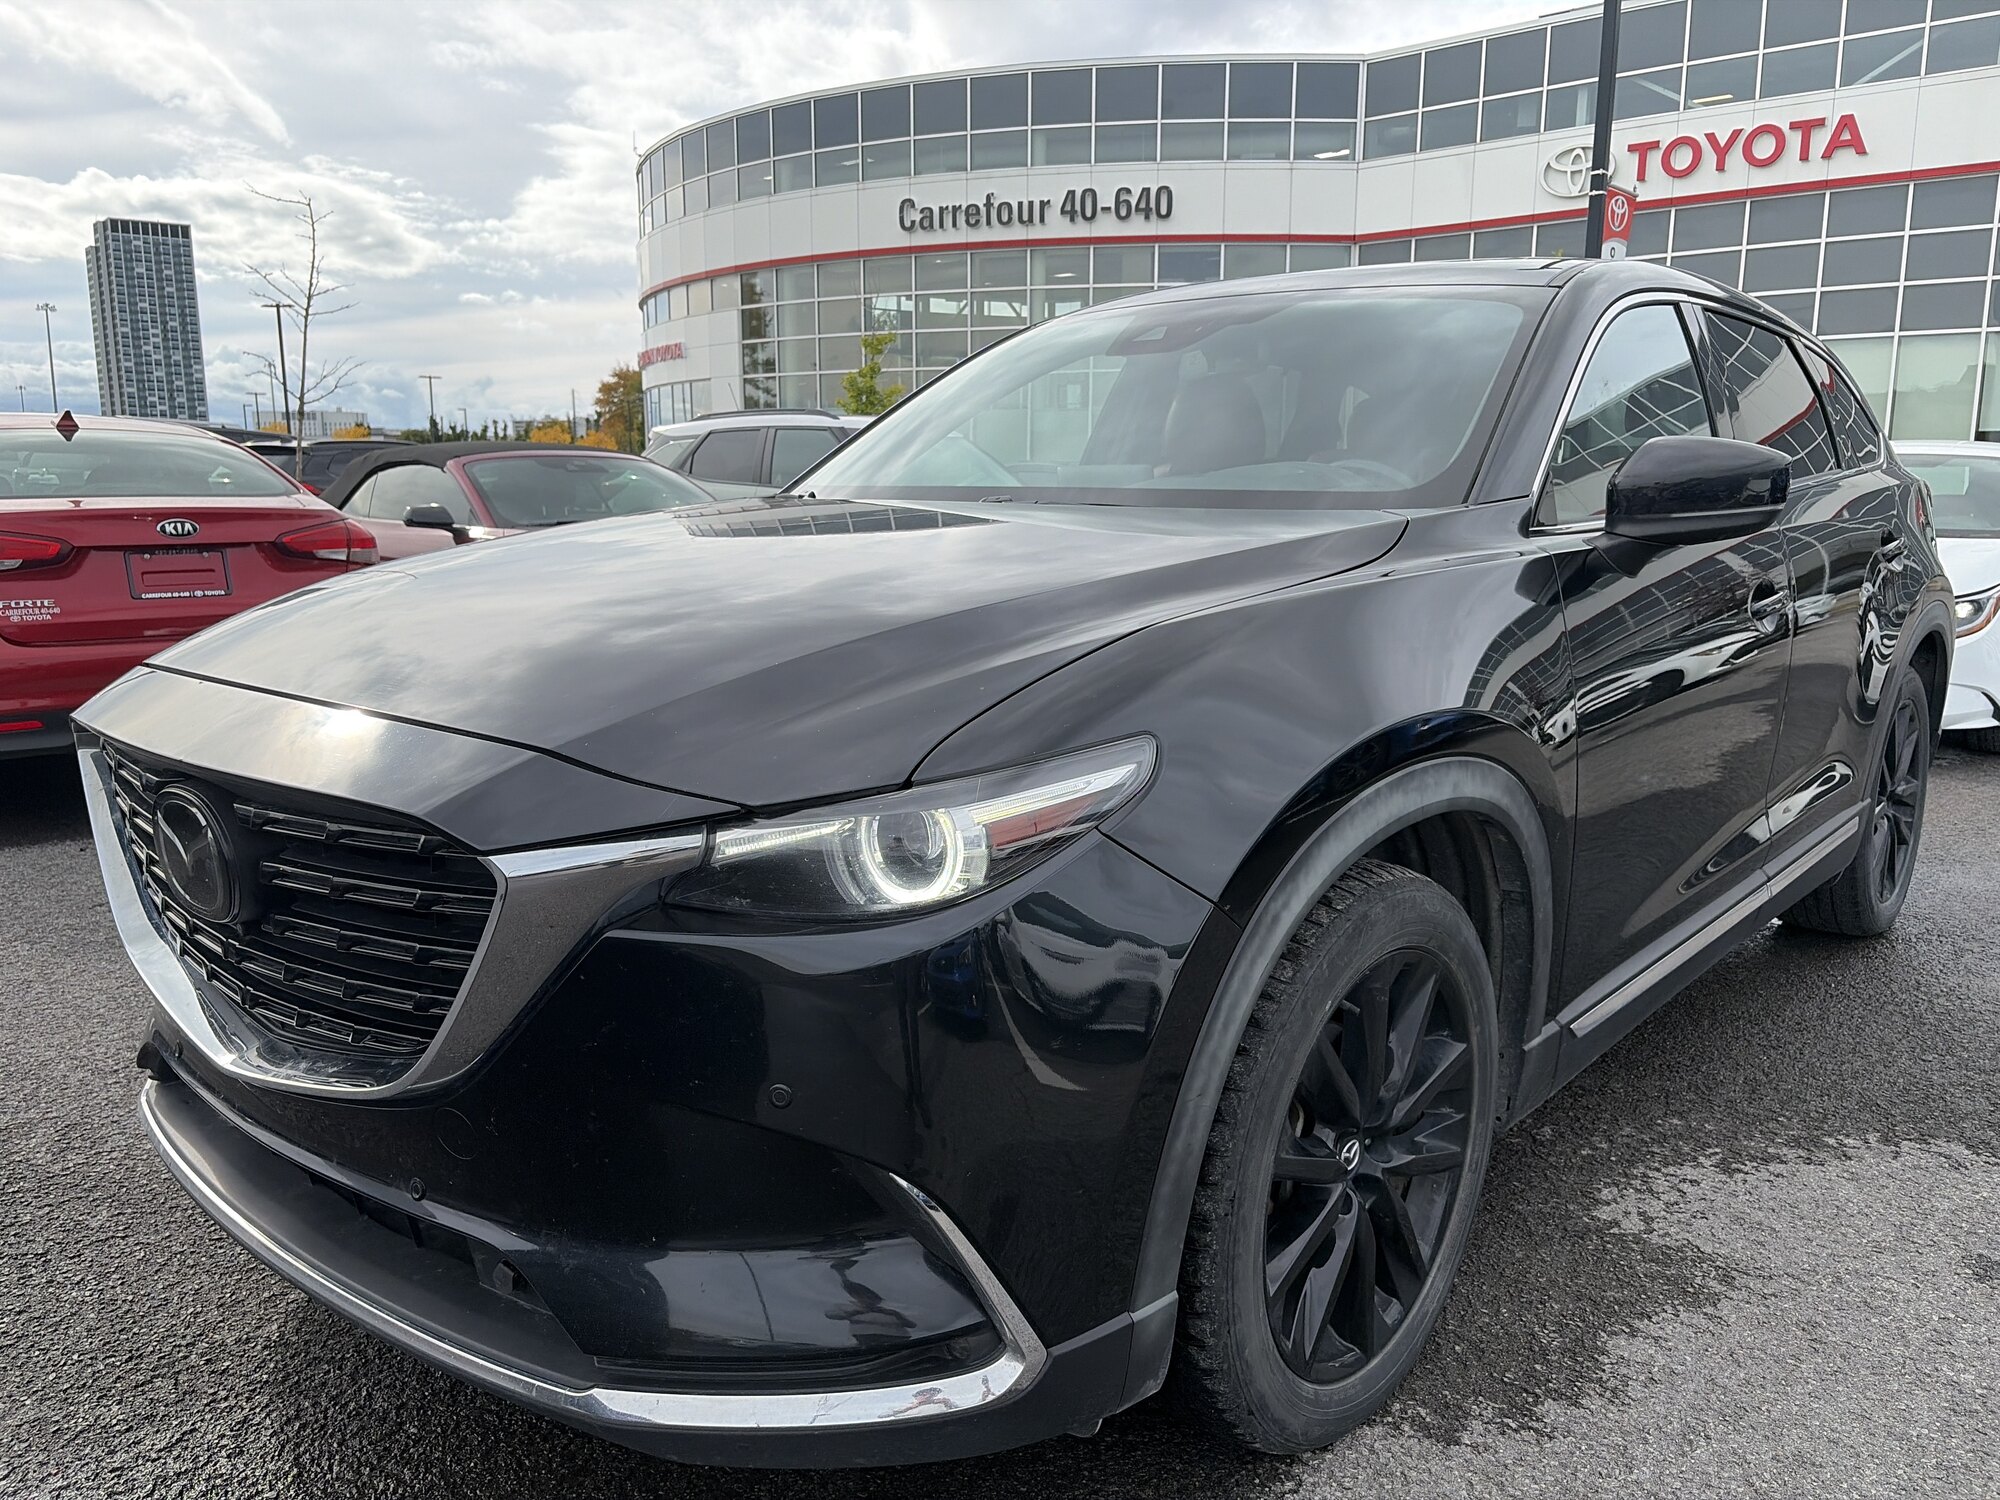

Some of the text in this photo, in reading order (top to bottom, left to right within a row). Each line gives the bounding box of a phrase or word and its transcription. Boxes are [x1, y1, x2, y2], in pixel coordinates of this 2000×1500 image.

[1627, 113, 1868, 182] TOYOTA
[899, 185, 1174, 232] Carrefour 40-640
[164, 522, 195, 535] KIA
[0, 599, 55, 608] FORTE
[0, 608, 40, 616] CARREFOUR
